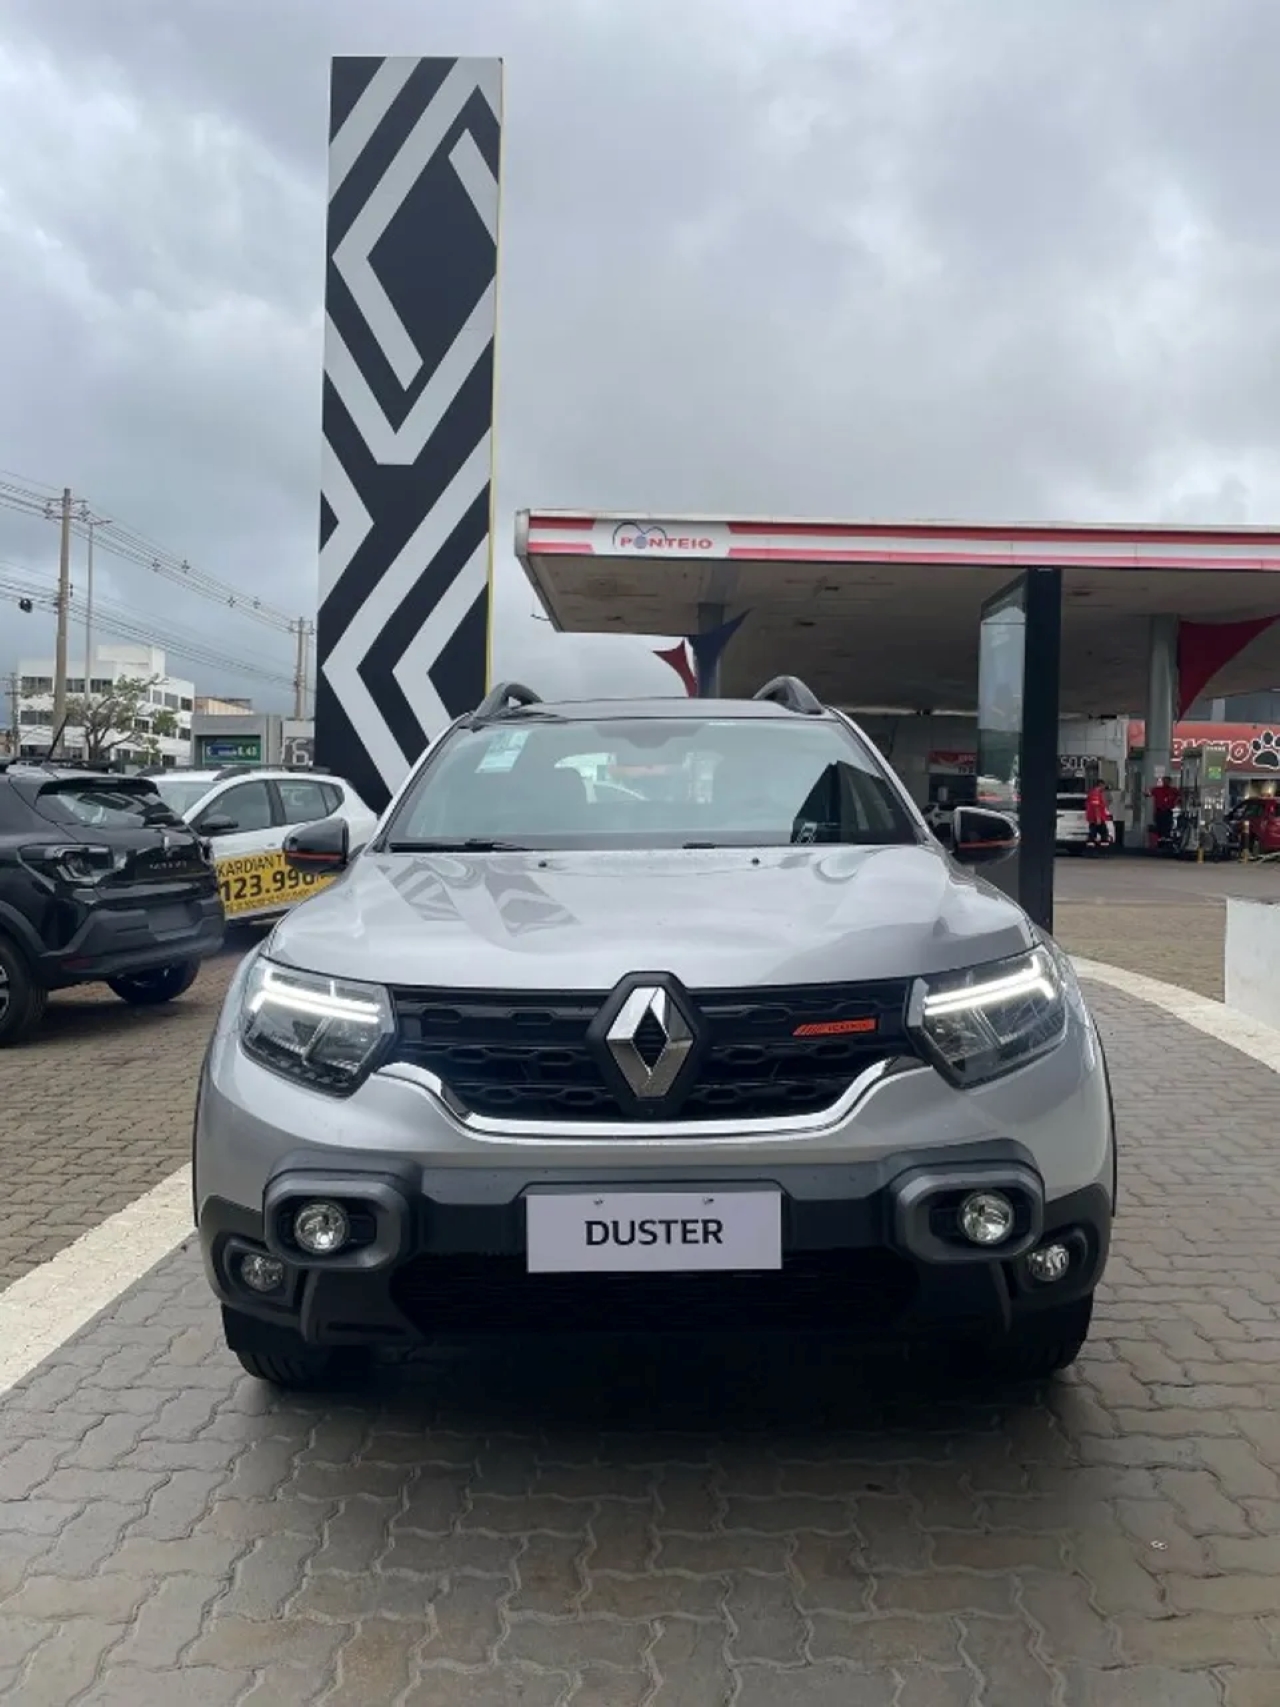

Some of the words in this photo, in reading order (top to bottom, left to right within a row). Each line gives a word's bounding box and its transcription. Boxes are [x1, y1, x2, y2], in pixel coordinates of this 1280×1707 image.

[620, 534, 713, 549] PONTEIO
[216, 855, 274, 877] KARDIAN
[276, 854, 283, 866] T
[584, 1218, 724, 1246] DUSTER
